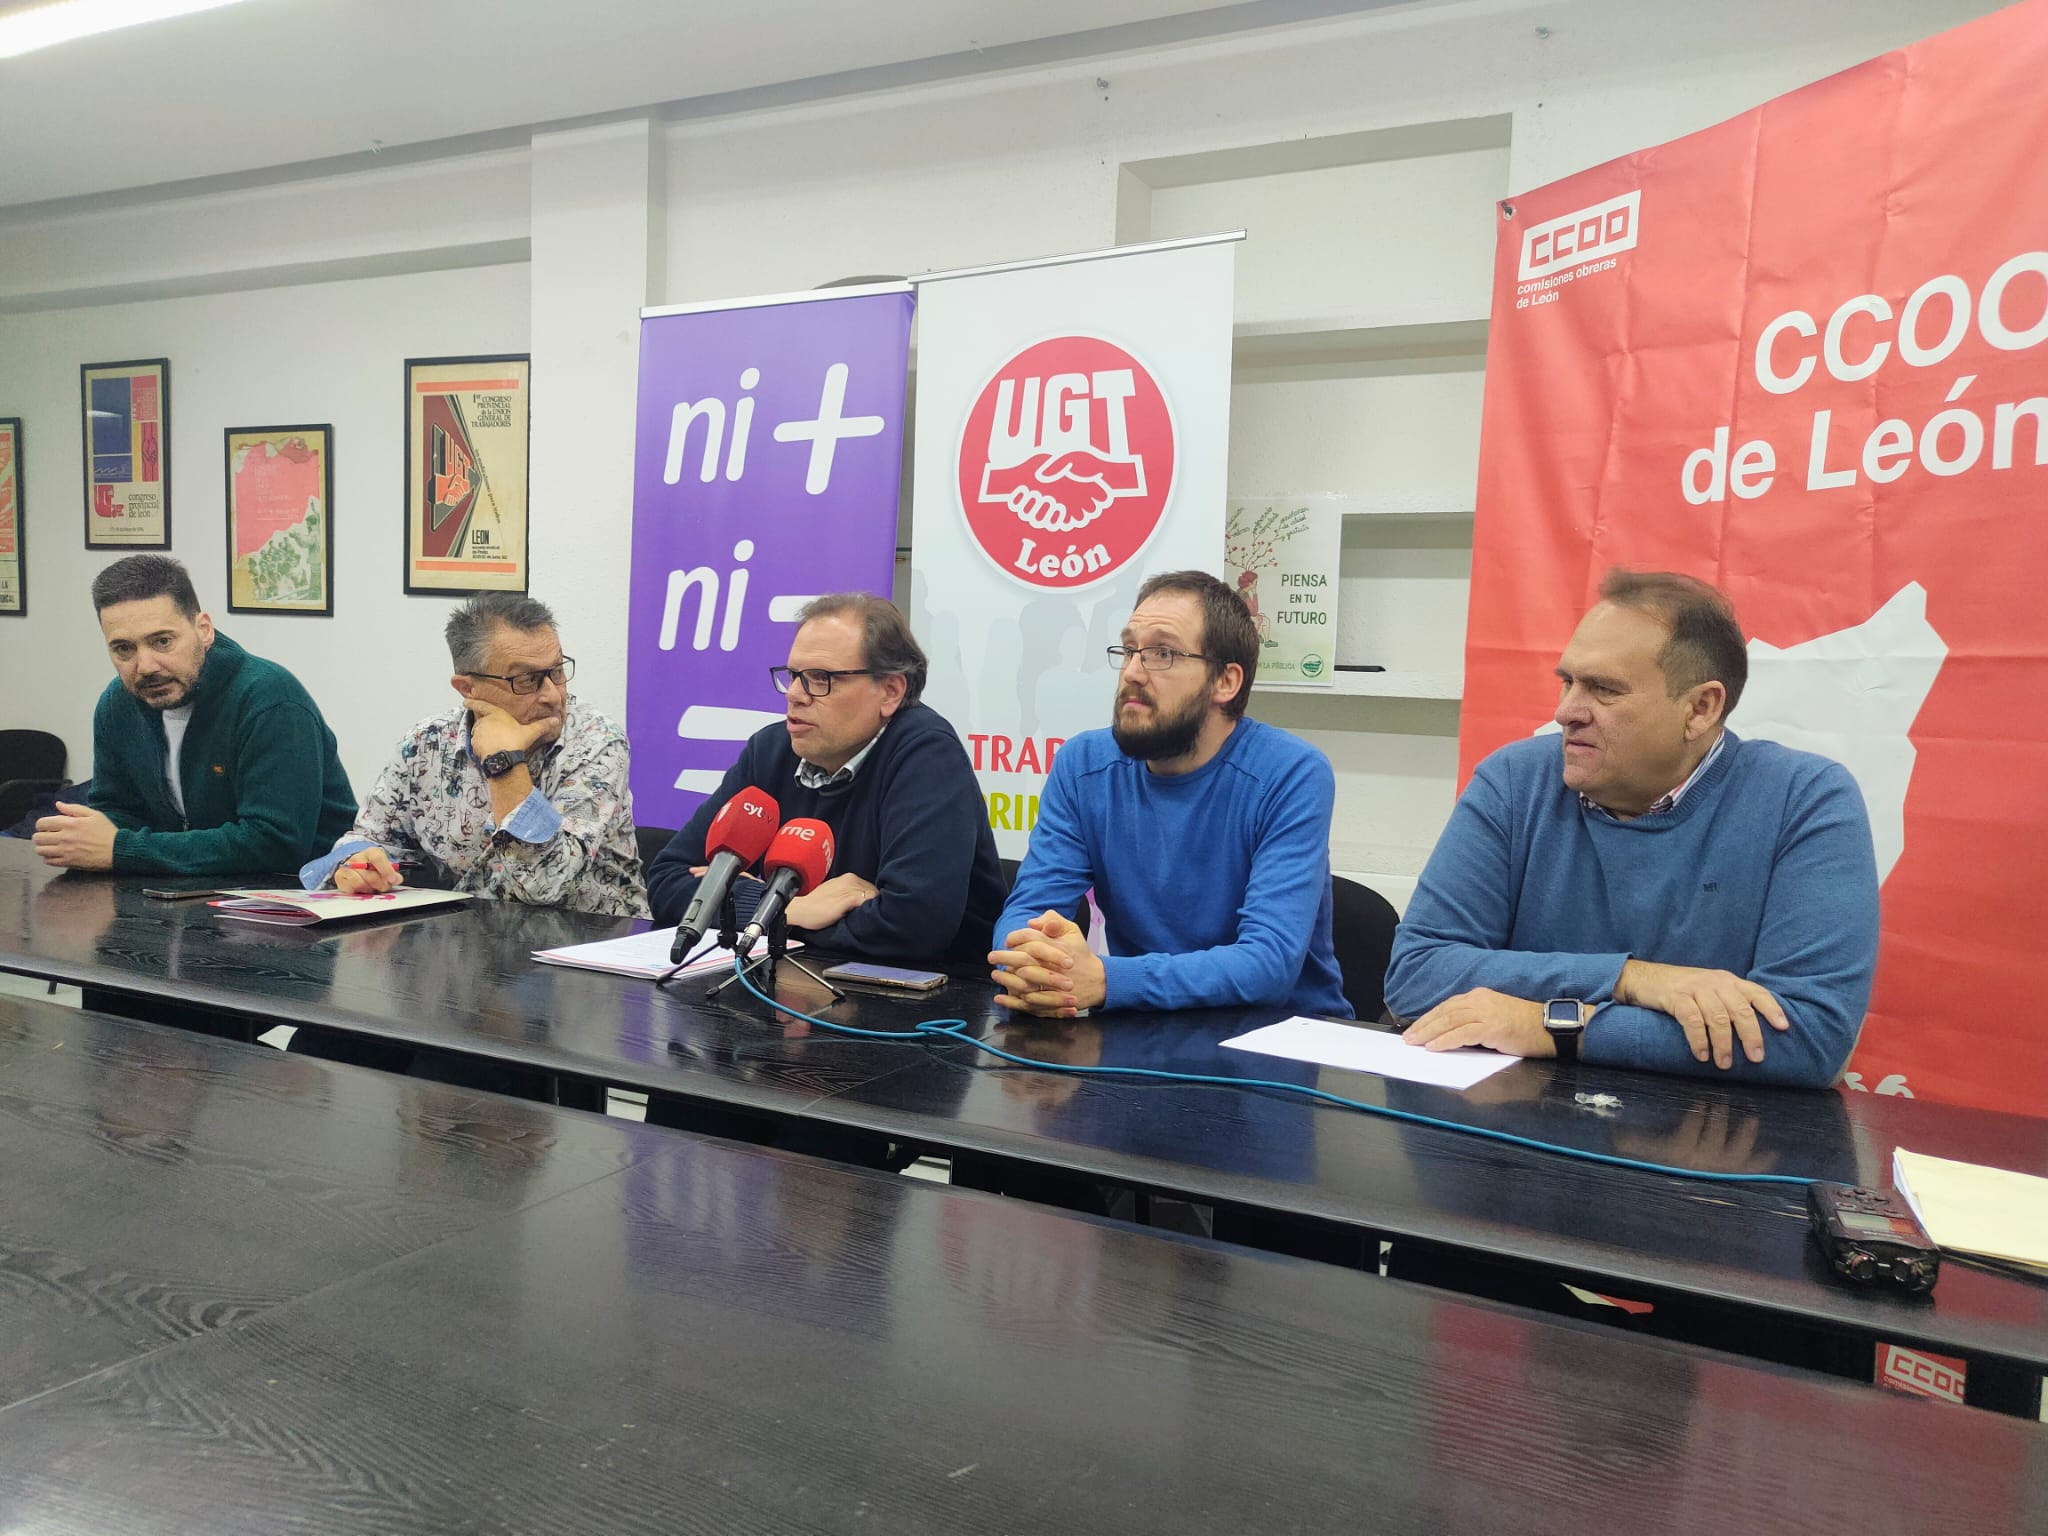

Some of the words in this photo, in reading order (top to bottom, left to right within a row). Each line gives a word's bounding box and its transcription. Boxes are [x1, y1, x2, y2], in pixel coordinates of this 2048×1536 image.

[1528, 205, 1630, 269] CCOO
[1517, 271, 1574, 296] comisiones
[1576, 258, 1617, 279] obreras
[1516, 297, 1530, 310] de
[1531, 290, 1560, 306] León
[1755, 251, 2048, 395] CCOO
[663, 367, 761, 486] ni
[987, 368, 1137, 471] UGT
[1681, 425, 1777, 506] de
[1806, 374, 2048, 492] León
[471, 529, 490, 545] LEON
[1014, 538, 1111, 579] León
[658, 539, 755, 653] ni
[1281, 573, 1327, 588] PIENSA
[1289, 593, 1302, 604] EN
[1304, 593, 1317, 604] TU
[1277, 610, 1327, 625] FUTURO
[780, 826, 816, 842] rne
